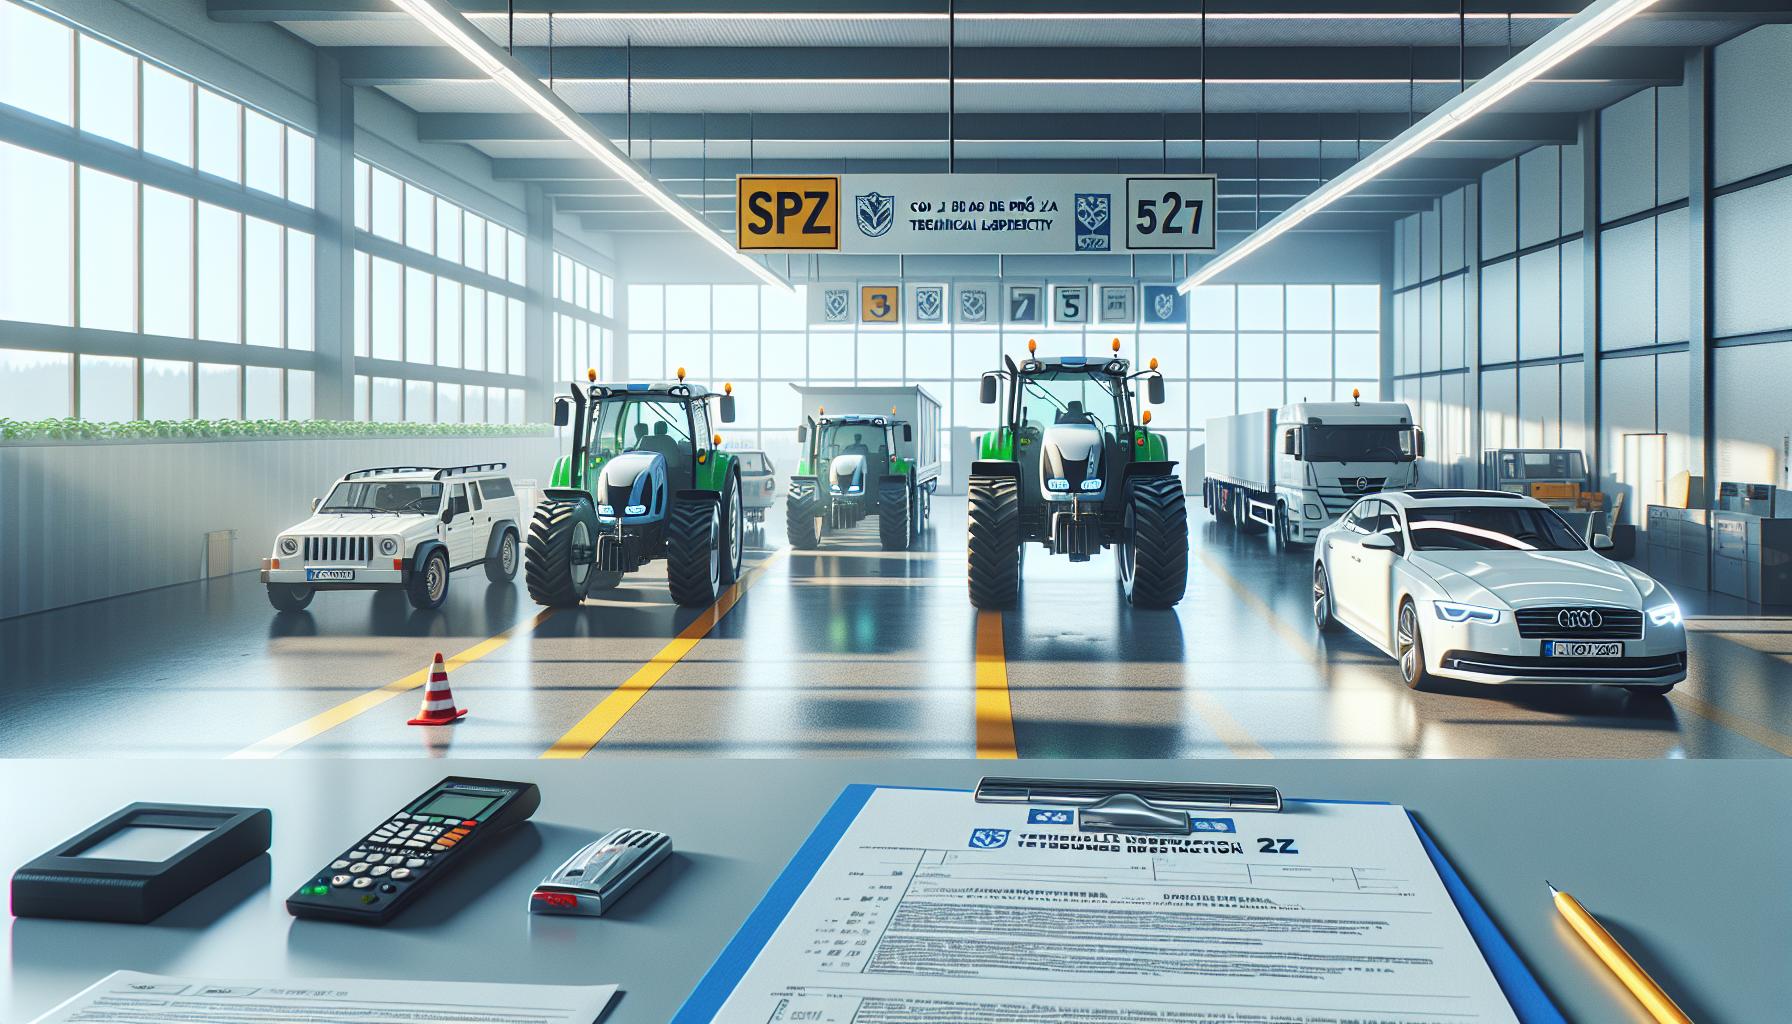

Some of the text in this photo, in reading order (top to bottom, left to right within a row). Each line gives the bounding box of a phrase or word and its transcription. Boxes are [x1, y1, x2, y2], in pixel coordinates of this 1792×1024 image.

[748, 190, 831, 235] SPZ
[1136, 191, 1204, 234] 527
[870, 294, 891, 318] 3
[1062, 294, 1080, 318] 5
